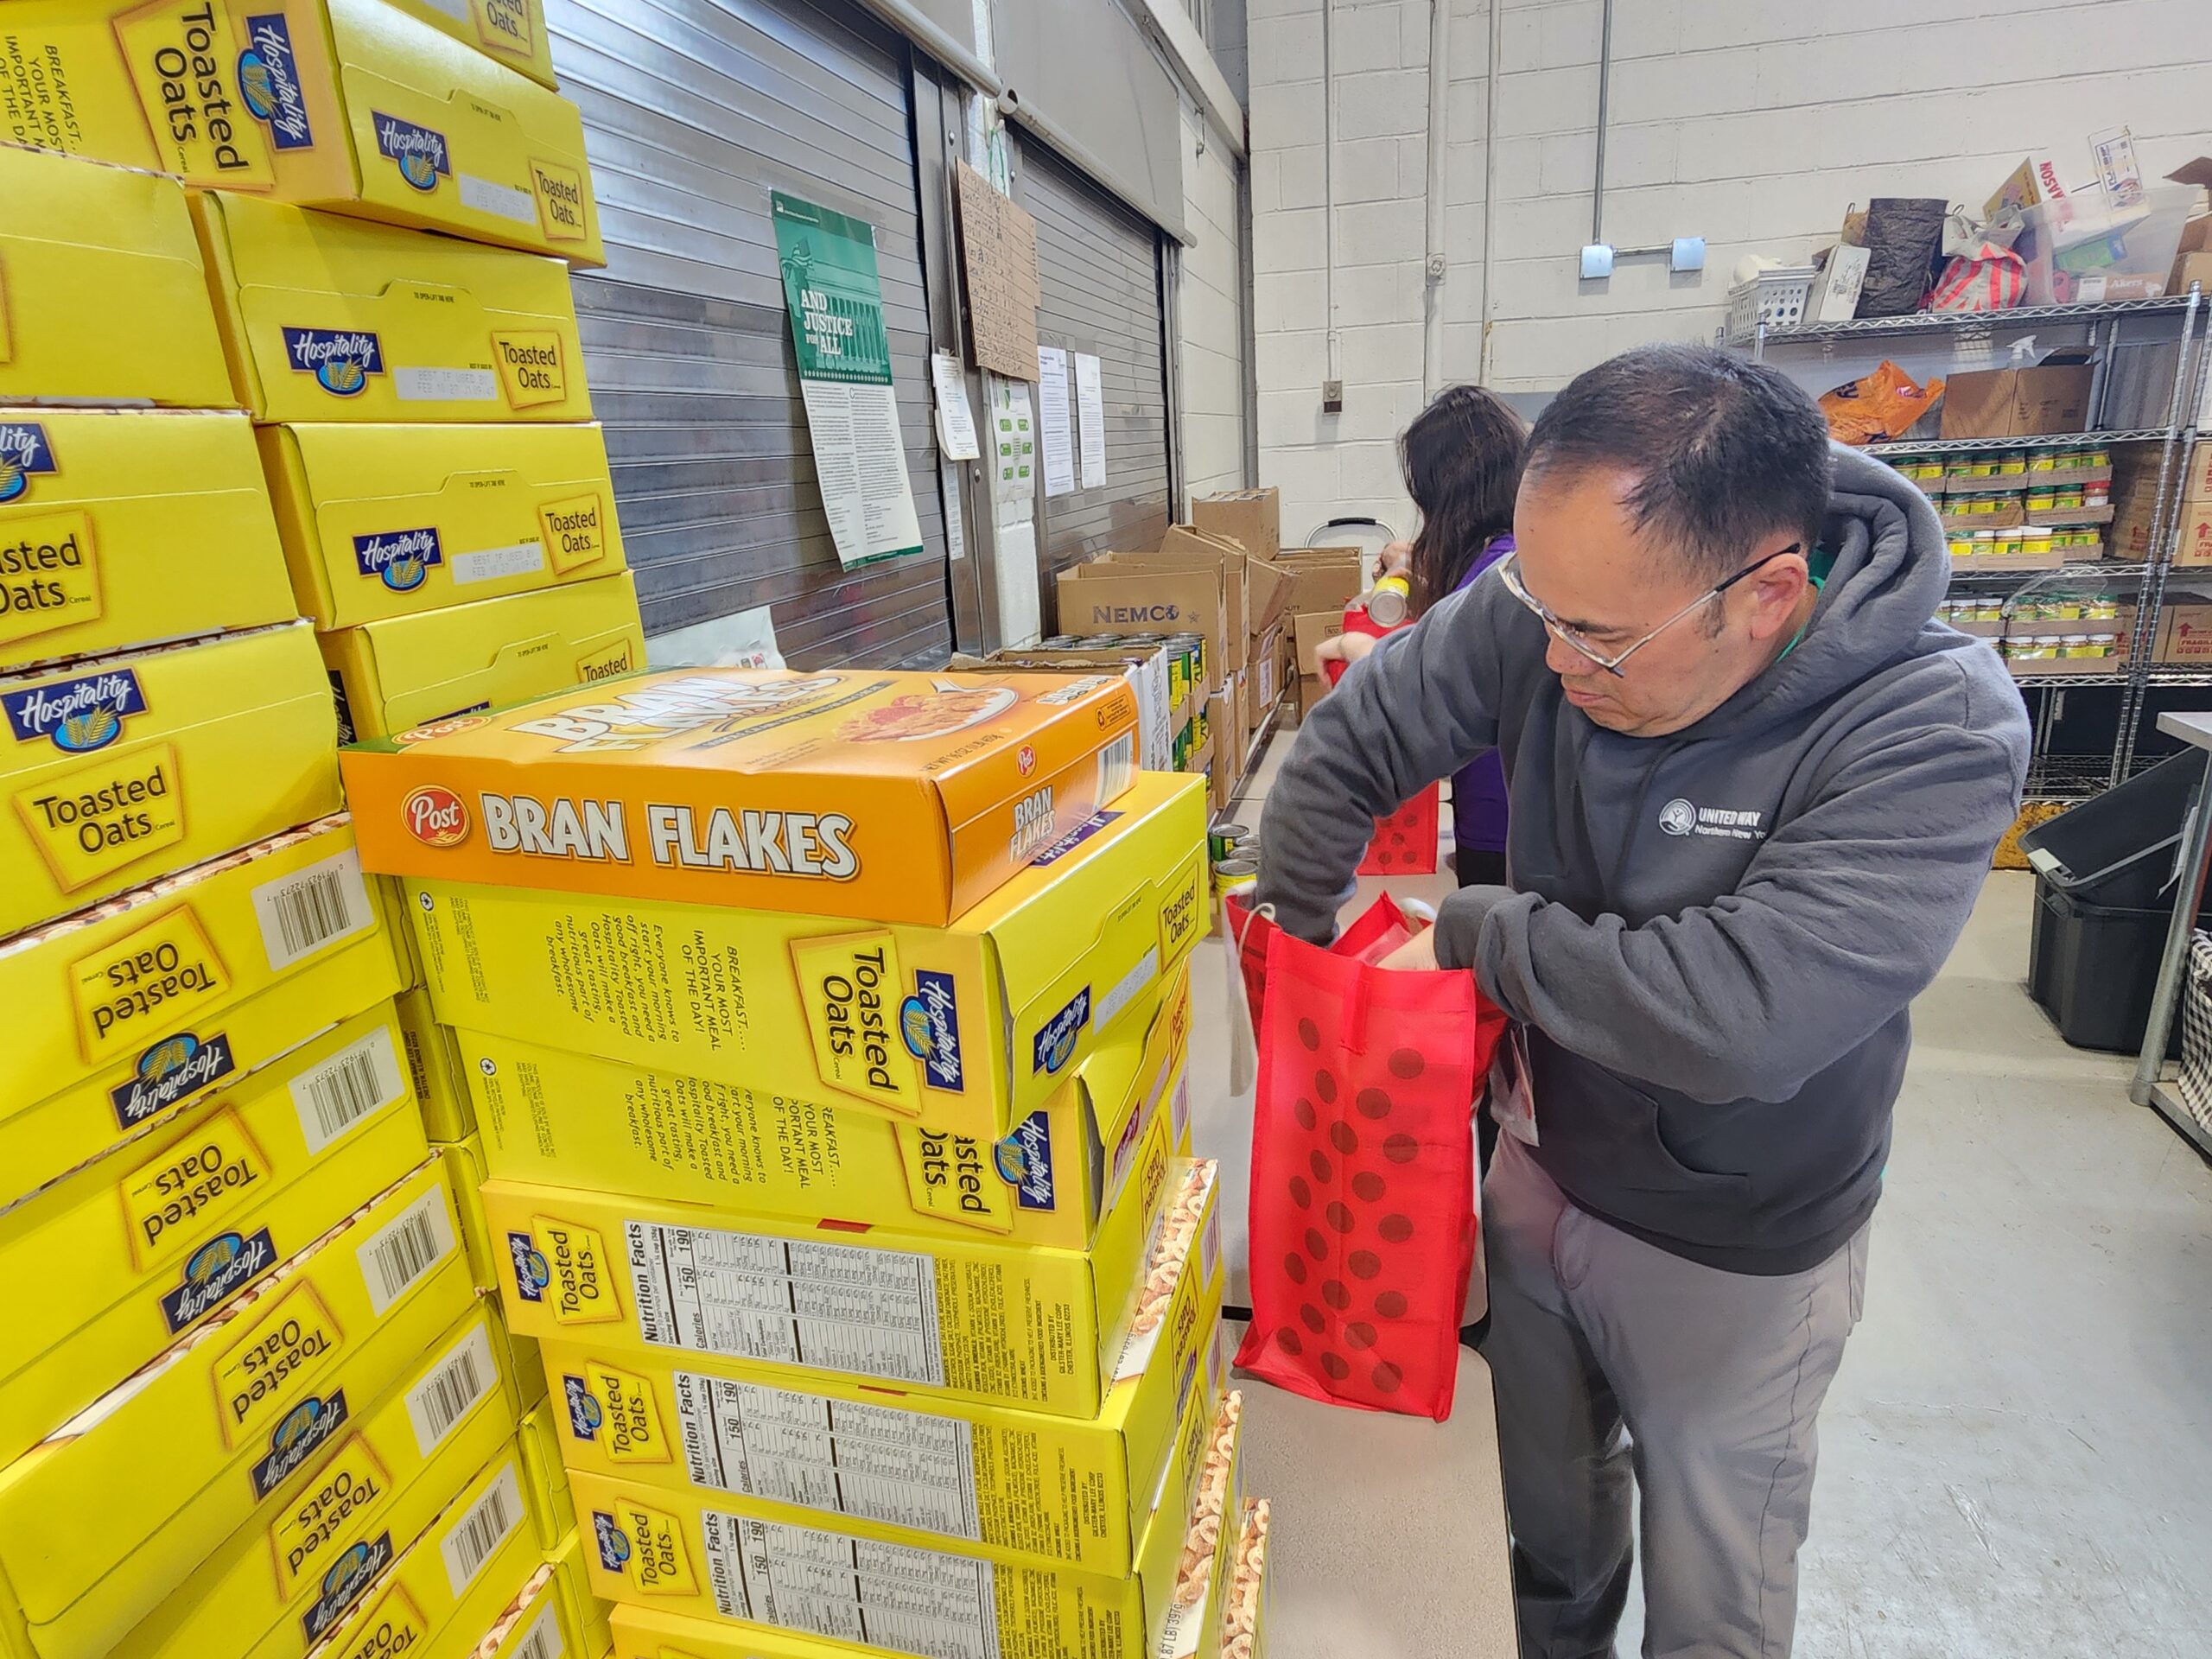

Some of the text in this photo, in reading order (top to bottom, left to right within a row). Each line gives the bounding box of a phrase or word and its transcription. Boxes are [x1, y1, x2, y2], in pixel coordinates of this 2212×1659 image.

[486, 2, 518, 37] Oats
[3, 88, 20, 118] THE
[5, 35, 41, 132] IMPORTANT
[28, 58, 49, 104] YOUR
[181, 2, 250, 169] Toasted
[252, 24, 308, 141] Hospitality
[155, 48, 196, 173] Oats Cereal
[380, 121, 442, 166] Hospitality
[536, 169, 579, 206] Toasted
[550, 199, 574, 226] Oats
[801, 289, 827, 311] AND
[804, 312, 853, 336] JUSTICE
[293, 331, 375, 368] Hospitality
[499, 341, 556, 365] Toasted
[820, 337, 841, 354] ALL
[518, 367, 551, 389] Oats
[545, 507, 596, 532] Toasted
[562, 533, 591, 553] Oats
[363, 531, 434, 570] Hospitality
[1093, 606, 1179, 624] NEMCO
[583, 653, 627, 682] Toasted
[16, 673, 132, 733] Hospitality
[505, 677, 760, 743] BRAN
[554, 677, 842, 753] FLAKES
[404, 720, 474, 740] Post
[1019, 752, 1033, 772] Post
[33, 766, 167, 829] Toasted
[411, 793, 461, 835] Post
[1014, 785, 1053, 832] BRAN
[1699, 808, 1761, 827] UNITED WAY
[79, 810, 175, 854] Oats Cereal
[479, 790, 861, 881] BRAN FLAKES
[1010, 810, 1056, 862] FLAKES
[1695, 824, 1766, 839] Northern New Yo
[280, 872, 331, 898] 71923 72273
[1162, 880, 1195, 926] Toasted
[591, 922, 601, 950] Oats
[626, 915, 638, 934] off
[1170, 912, 1191, 944] Oats
[107, 942, 179, 988] Oats
[546, 936, 564, 997] breakfast.
[555, 920, 579, 1013] any wholesome
[565, 915, 594, 1023] nutritious part of
[579, 931, 601, 1014] great tasting,
[596, 955, 608, 978] will
[601, 913, 632, 1036] Hospitality Toasted
[613, 917, 644, 1037] good breakfast and
[630, 937, 641, 971] right,
[92, 961, 216, 1039] Toasted
[601, 980, 613, 1013] make
[634, 976, 646, 999] you
[640, 923, 666, 1040] start your morning
[653, 925, 679, 1042] Everyone knows to
[682, 944, 705, 1032] OF THE DAY!
[694, 931, 721, 1051] IMPORTANT MEAL
[711, 954, 733, 1036] YOUR MOST
[641, 1002, 655, 1033] need
[823, 976, 854, 1080] Oats Cereal
[852, 947, 899, 1092] Toasted
[920, 979, 956, 1083] Hospitality
[1036, 992, 1089, 1063] Hospitality
[125, 1044, 224, 1119] Hospitality
[773, 1096, 794, 1173] OF THE DAY!
[804, 1103, 823, 1175] YOUR MOST
[155, 1145, 222, 1196] Oats
[797, 1157, 810, 1189] MEAL
[953, 1134, 993, 1214] asted
[1020, 1117, 1048, 1205] Hospitality
[143, 1158, 257, 1246] Toasted
[516, 1236, 537, 1297] Hospitality
[677, 1230, 690, 1252] 190
[174, 1241, 267, 1322] Hospitality
[548, 1230, 581, 1315] Toasted
[578, 1249, 599, 1300] Oats
[628, 1224, 658, 1342] Nutrition Facts
[681, 1268, 695, 1290] 150
[242, 1319, 301, 1375] Oats
[692, 1313, 705, 1349] Calories
[232, 1328, 332, 1424] Toasted
[723, 1382, 736, 1404] 190
[567, 1378, 592, 1436] Hospitality
[600, 1376, 632, 1454] Toasted
[630, 1399, 649, 1443] Oats
[677, 1375, 706, 1484] Nutrition Facts
[728, 1418, 741, 1439] 150
[263, 1402, 341, 1488] Hospitality
[298, 1471, 353, 1526] Oats
[739, 1460, 750, 1493] Calories
[287, 1476, 381, 1577] Toasted
[597, 1515, 620, 1568] Hospitality
[629, 1513, 660, 1586] Toasted
[750, 1521, 763, 1541] 190
[658, 1535, 677, 1576] Oats
[705, 1513, 733, 1615] Nutrition Facts
[754, 1555, 767, 1574] 150
[311, 1543, 390, 1632] Hospitality
[765, 1595, 776, 1624] Calories
[1160, 1604, 1185, 1659] .87 LB) 397g
